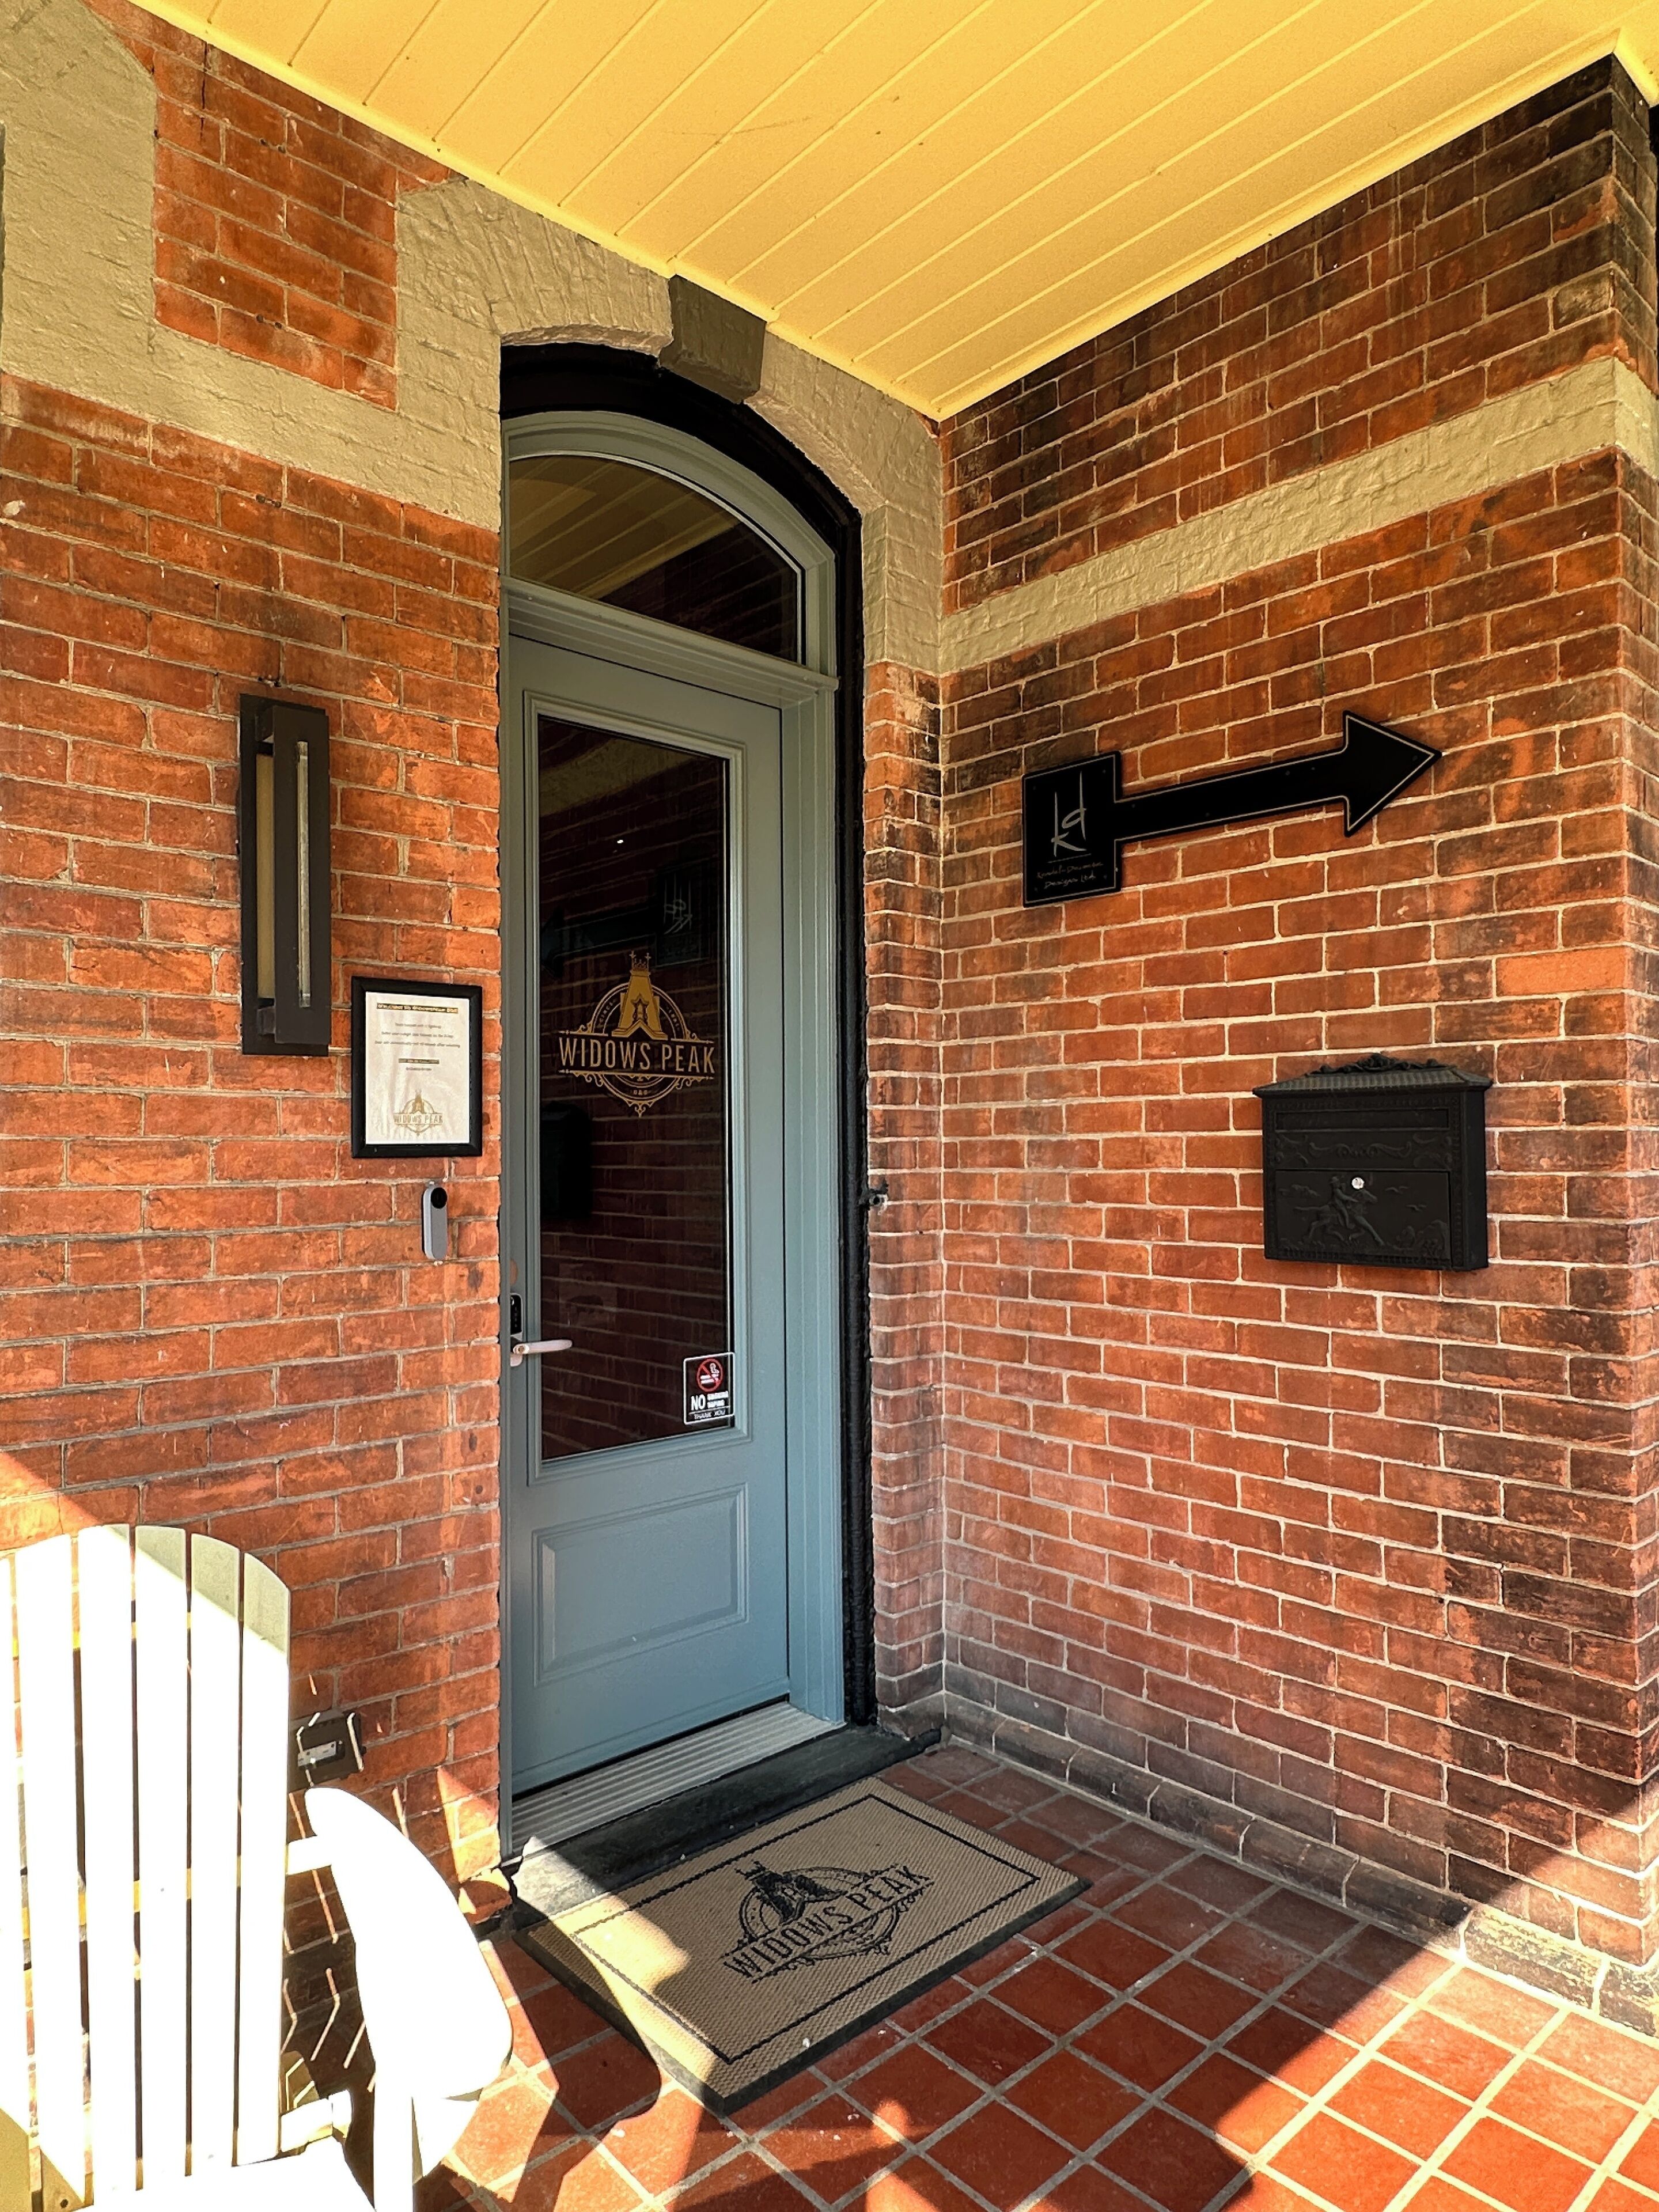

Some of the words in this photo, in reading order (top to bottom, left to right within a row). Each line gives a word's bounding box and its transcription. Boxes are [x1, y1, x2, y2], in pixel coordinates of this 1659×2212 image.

[559, 1037, 651, 1070] WIDOWS
[662, 1044, 715, 1074] PEAK
[393, 1115, 422, 1123] WIDOWS
[425, 1115, 443, 1123] PEAK
[691, 1394, 706, 1411] NO
[724, 1906, 853, 1978] WIDOWS
[846, 1865, 930, 1911] PEAK
